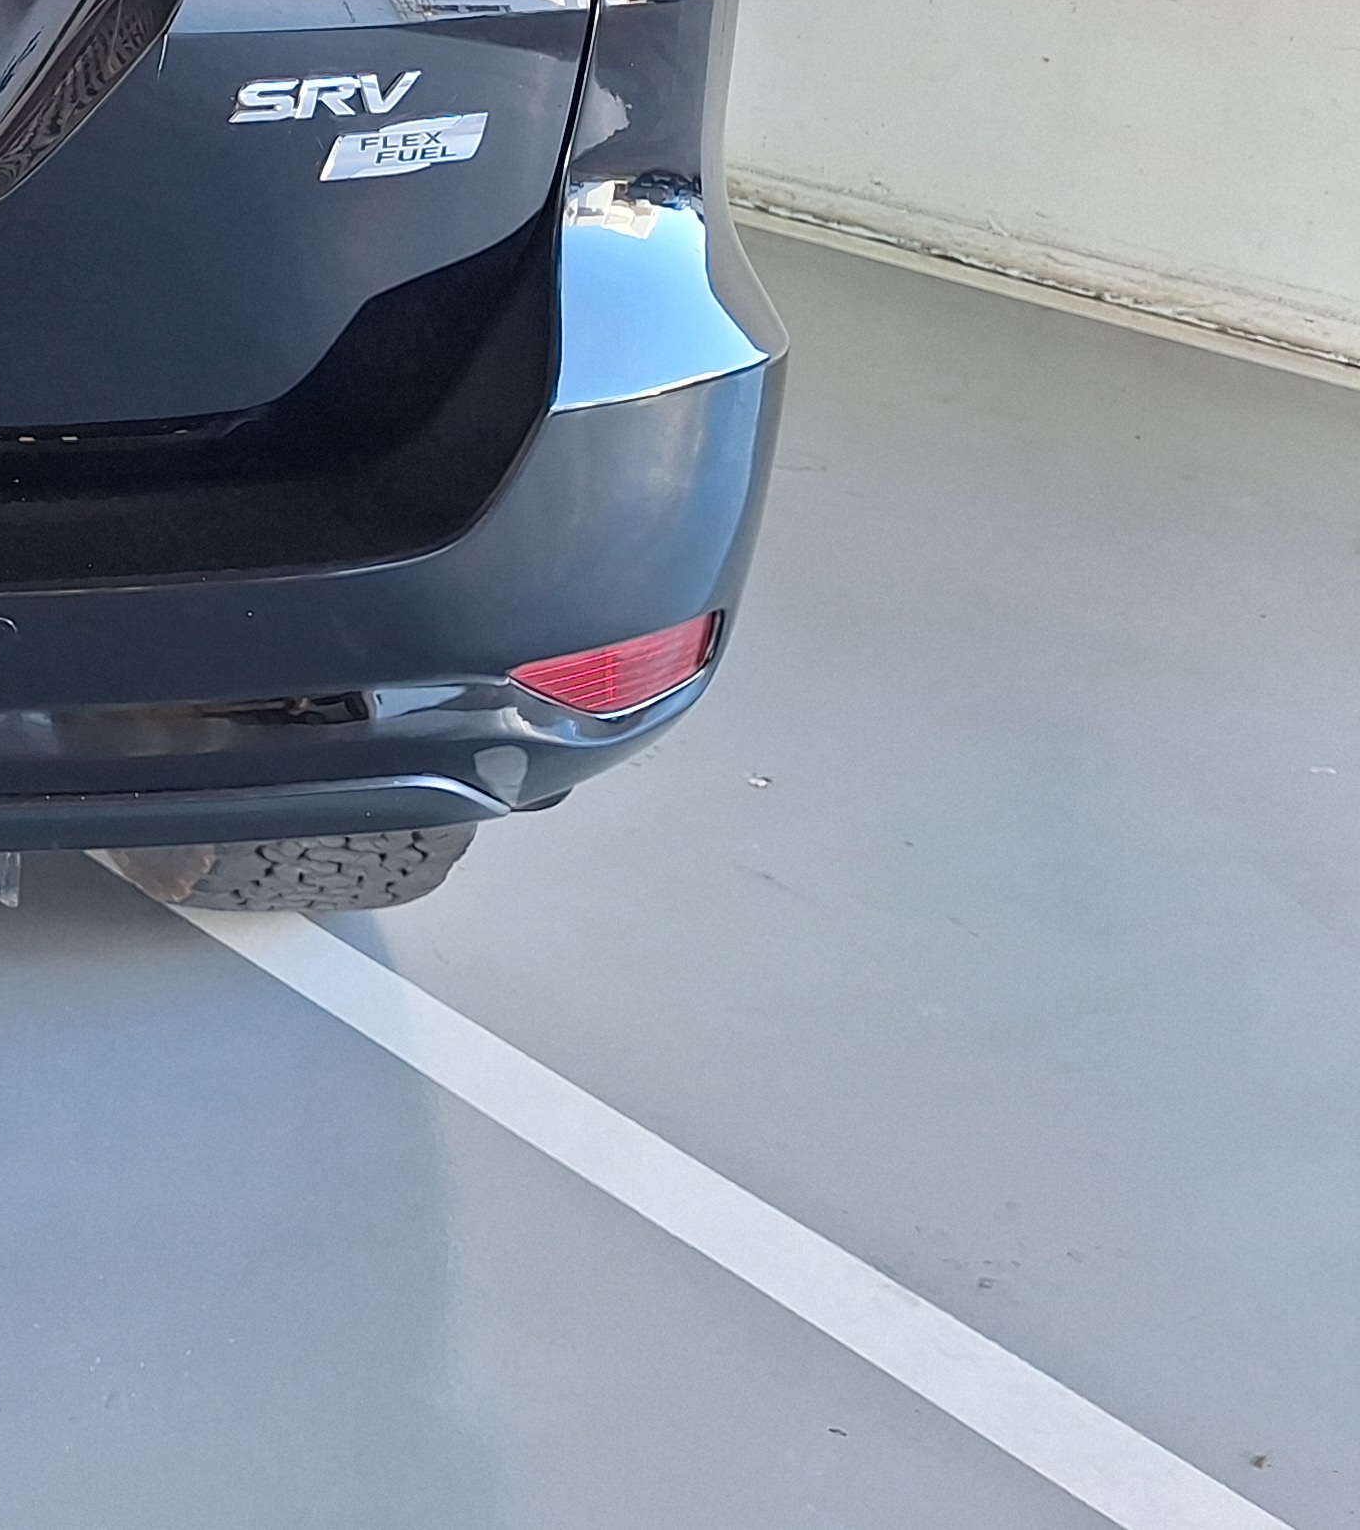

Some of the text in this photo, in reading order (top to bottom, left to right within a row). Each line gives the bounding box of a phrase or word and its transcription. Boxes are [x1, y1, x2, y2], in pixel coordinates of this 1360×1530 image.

[228, 69, 422, 123] SRV
[359, 131, 442, 151] FLEX
[374, 146, 457, 165] FUEL
